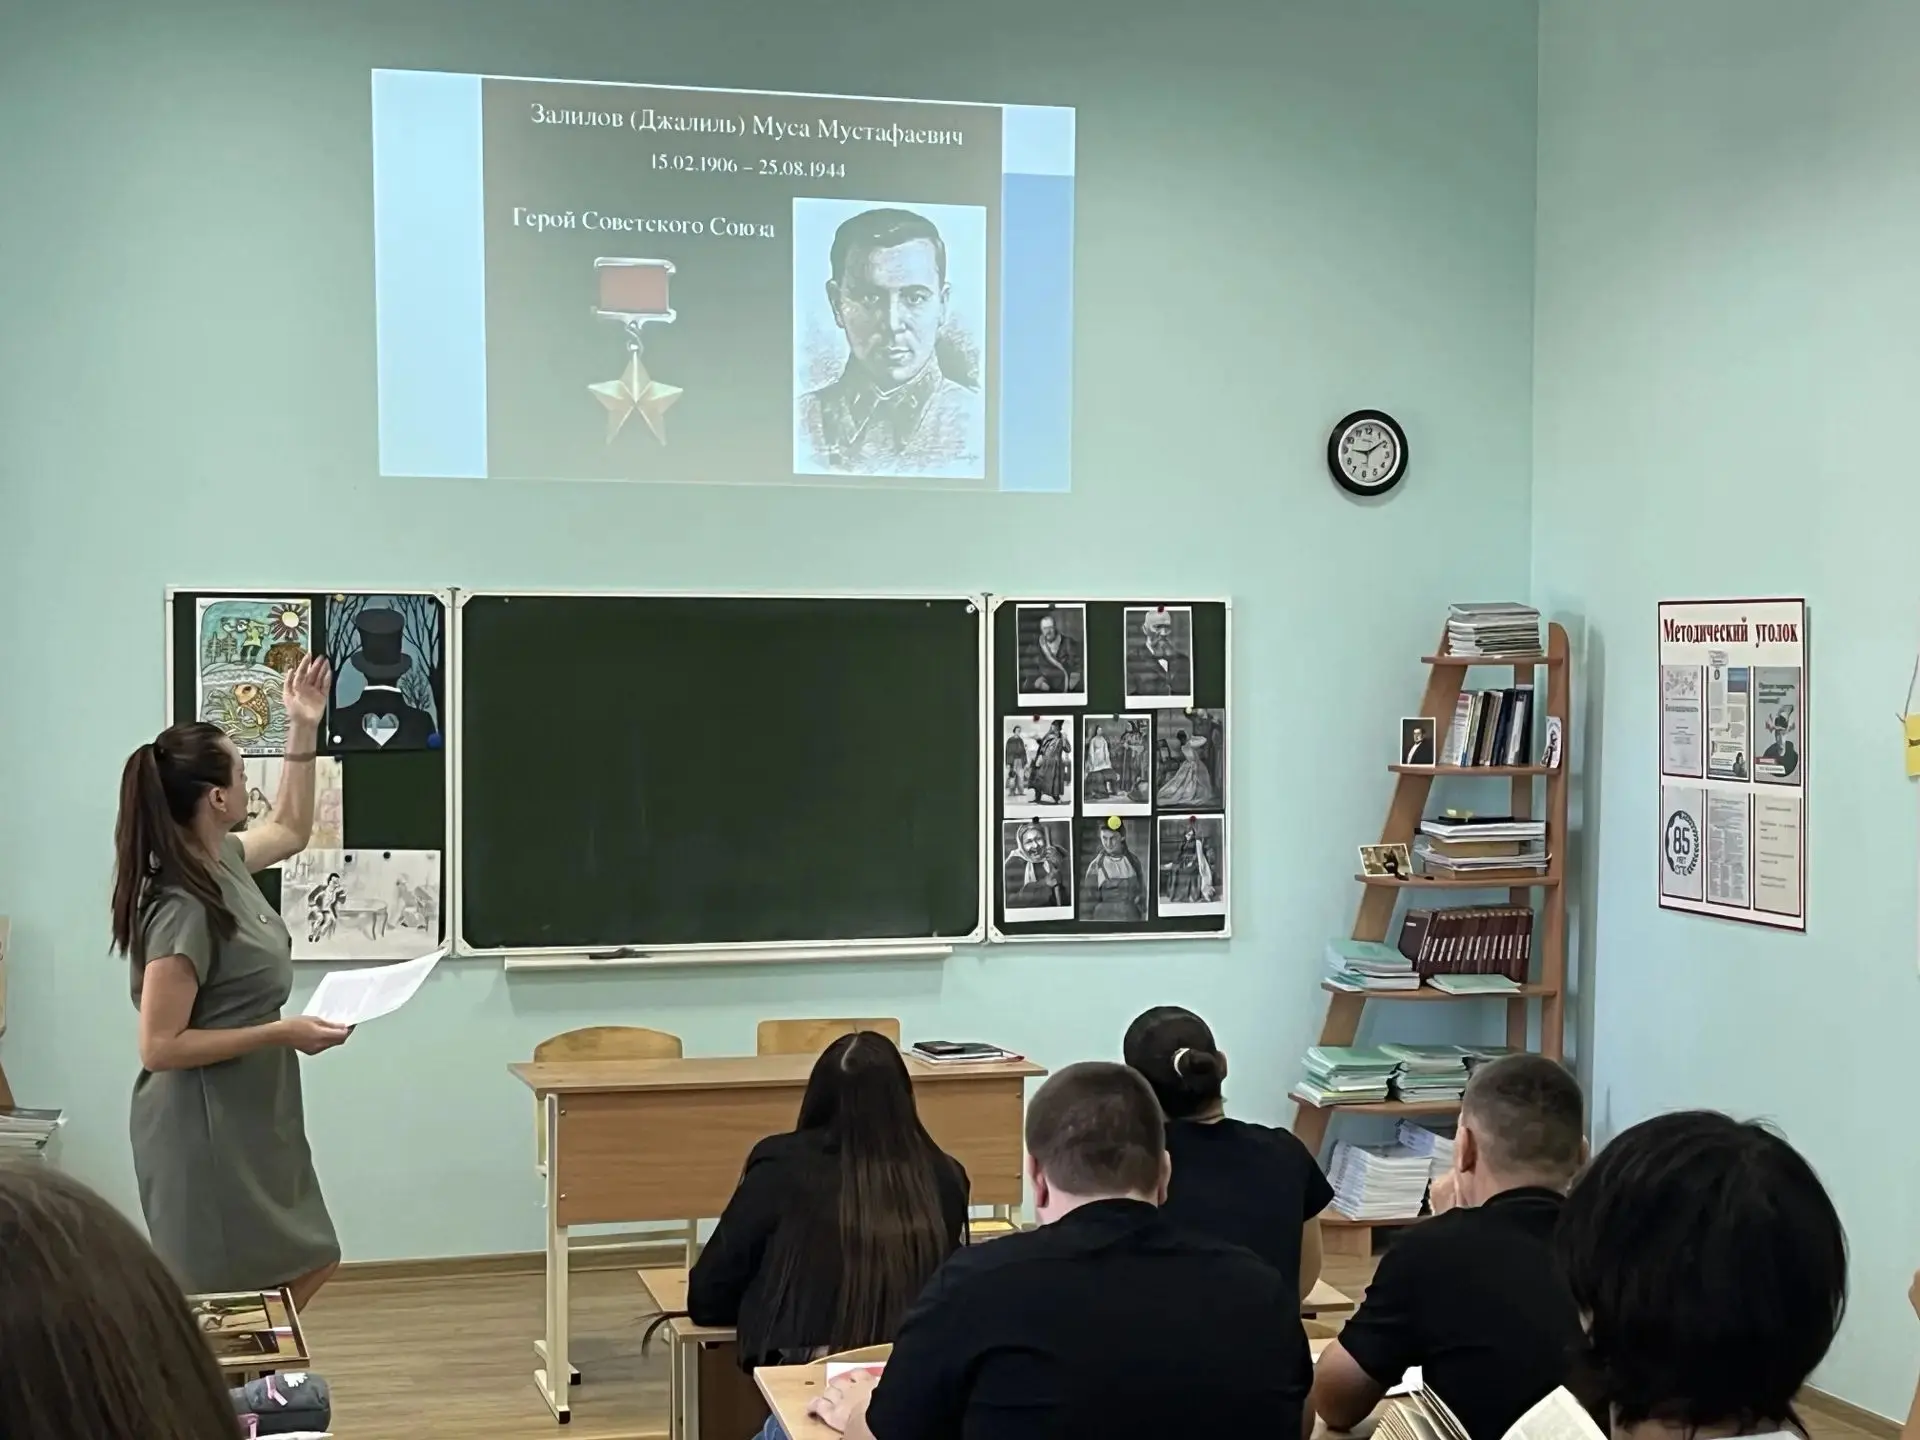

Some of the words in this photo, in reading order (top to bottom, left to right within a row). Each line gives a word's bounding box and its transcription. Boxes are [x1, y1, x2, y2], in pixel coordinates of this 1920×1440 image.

[530, 103, 624, 128] Залилов
[630, 108, 746, 137] (Джалиль)
[752, 115, 811, 141] Муса
[817, 118, 964, 147] Мустафаевич
[651, 153, 738, 173] 15.02.1906
[758, 159, 846, 178] 25.08.1944
[512, 206, 577, 233] Герой
[582, 211, 704, 236] Советского
[709, 216, 775, 238] Союза
[1663, 616, 1749, 644] Методический
[1755, 622, 1799, 648] уголок
[1673, 826, 1690, 855] 85
